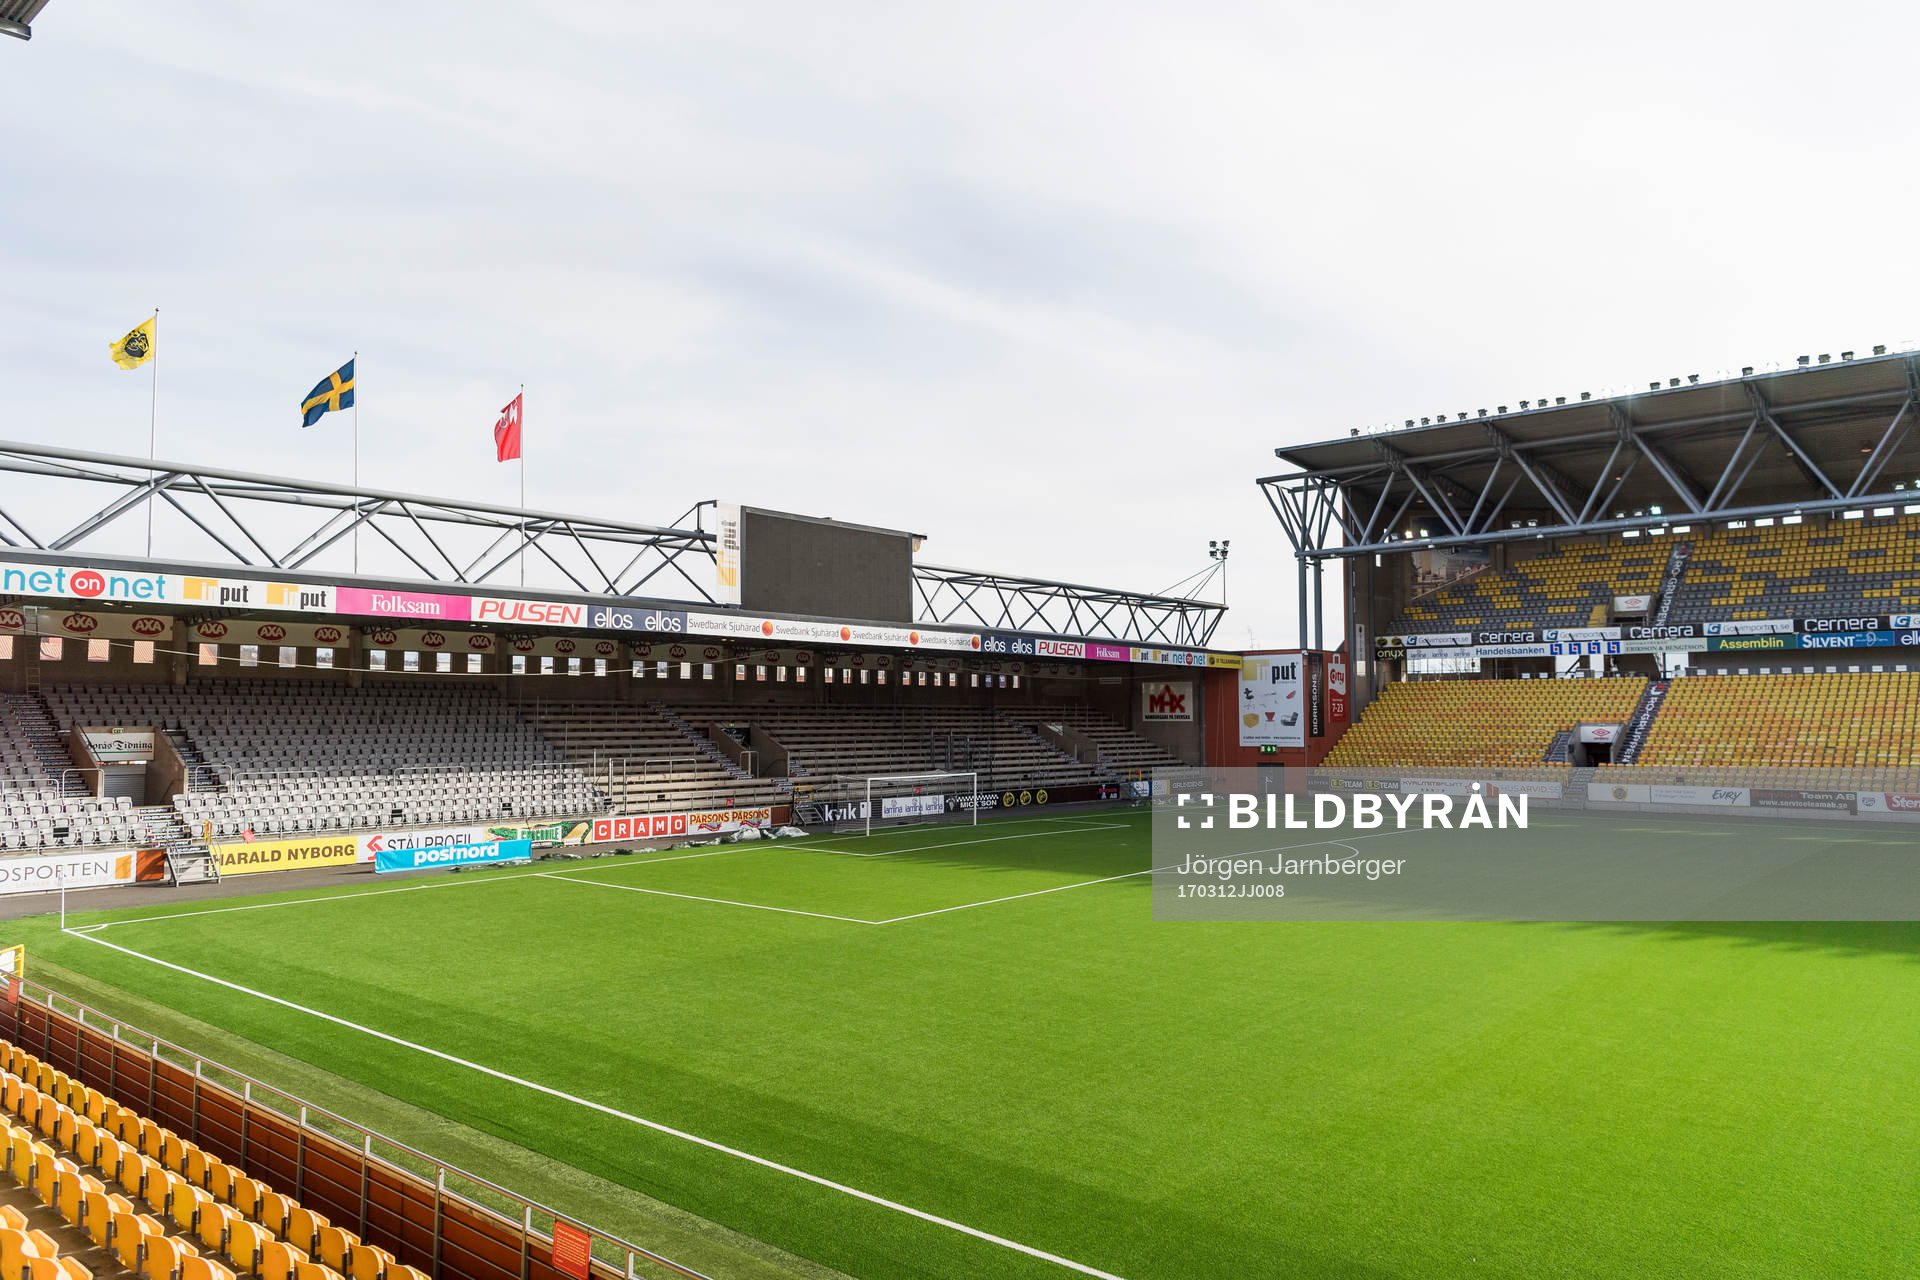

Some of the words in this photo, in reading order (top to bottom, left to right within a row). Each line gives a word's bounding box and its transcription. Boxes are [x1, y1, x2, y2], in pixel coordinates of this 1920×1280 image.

[4, 567, 66, 594] net
[74, 577, 101, 591] on
[109, 575, 166, 600] net
[371, 594, 441, 615] Folksam
[479, 600, 582, 624] PULSEN
[594, 607, 633, 629] ellos
[65, 615, 93, 629] AXA
[134, 619, 161, 632] AXA
[645, 610, 682, 632] ellos
[688, 619, 727, 630] Swedbank
[1804, 618, 1878, 632] Cernera
[199, 622, 225, 635] AXA
[259, 626, 284, 637] AXA
[316, 629, 339, 640] AXA
[776, 625, 810, 636] Swedbank
[1630, 624, 1694, 639] Cernera
[373, 632, 395, 643] AXA
[423, 634, 444, 645] AXA
[470, 637, 489, 647] AXA
[852, 630, 883, 641] Swedbank
[920, 635, 948, 645] Swedbank
[1479, 631, 1534, 644] Cernera
[1802, 634, 1856, 648] SILVENT
[515, 639, 533, 649] AXA
[556, 641, 574, 651] AXA
[596, 643, 613, 653] AXA
[984, 636, 1006, 652] ellos
[1012, 638, 1033, 655] ellos
[1038, 641, 1083, 657] PULSEN
[1719, 636, 1785, 650] Assemblin
[1095, 646, 1120, 659] Folksam
[1377, 648, 1405, 659] onyx
[1475, 646, 1545, 656] Handelsbanken
[1149, 684, 1186, 713] MAX
[1332, 703, 1344, 713] 7-23
[113, 740, 153, 751] Tidning
[1800, 792, 1835, 800] Team
[1836, 793, 1856, 801] AB
[732, 809, 769, 823] PARSONS
[883, 806, 903, 814] lamina
[690, 812, 730, 825] PARSONS
[599, 819, 683, 837] CRAMO
[212, 850, 282, 867] HARALD
[287, 844, 355, 861] NYBORG
[414, 842, 499, 866] postnord
